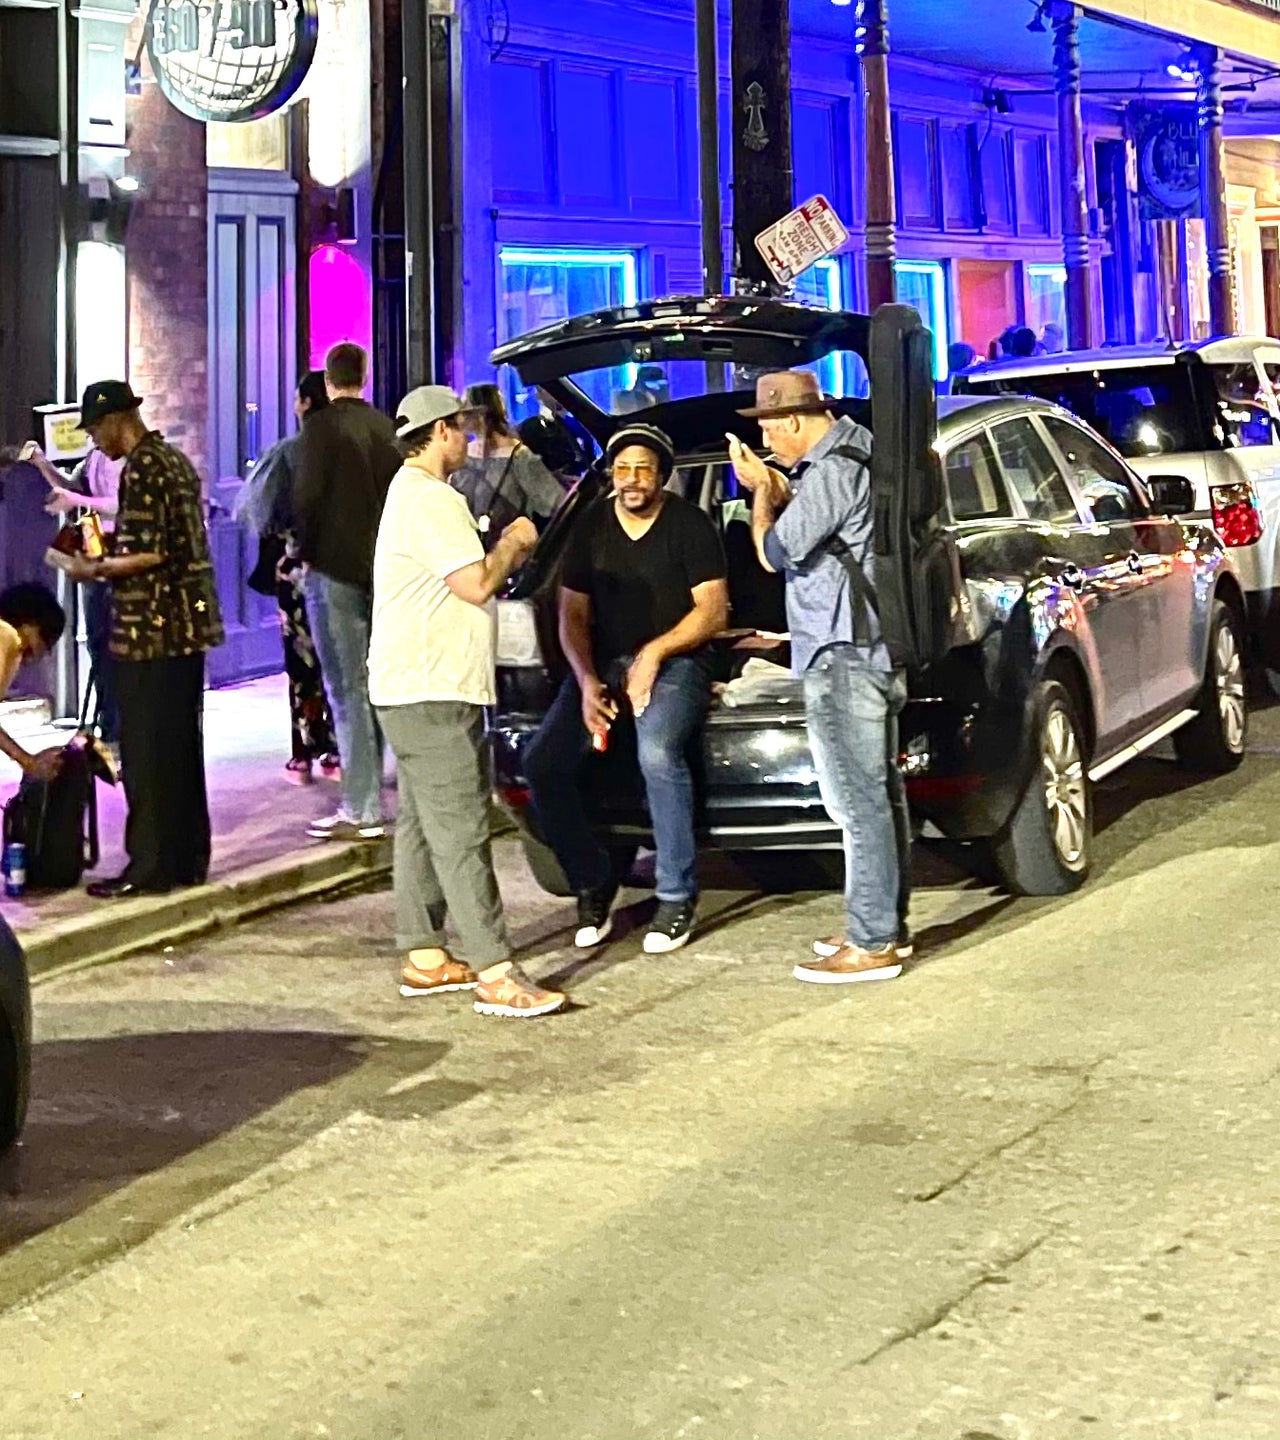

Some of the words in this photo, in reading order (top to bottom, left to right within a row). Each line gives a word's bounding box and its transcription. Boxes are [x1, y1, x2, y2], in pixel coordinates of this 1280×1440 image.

[1168, 122, 1198, 140] BLU
[804, 198, 824, 219] NO
[786, 228, 809, 257] ZONE
[791, 214, 823, 257] FREIGHT
